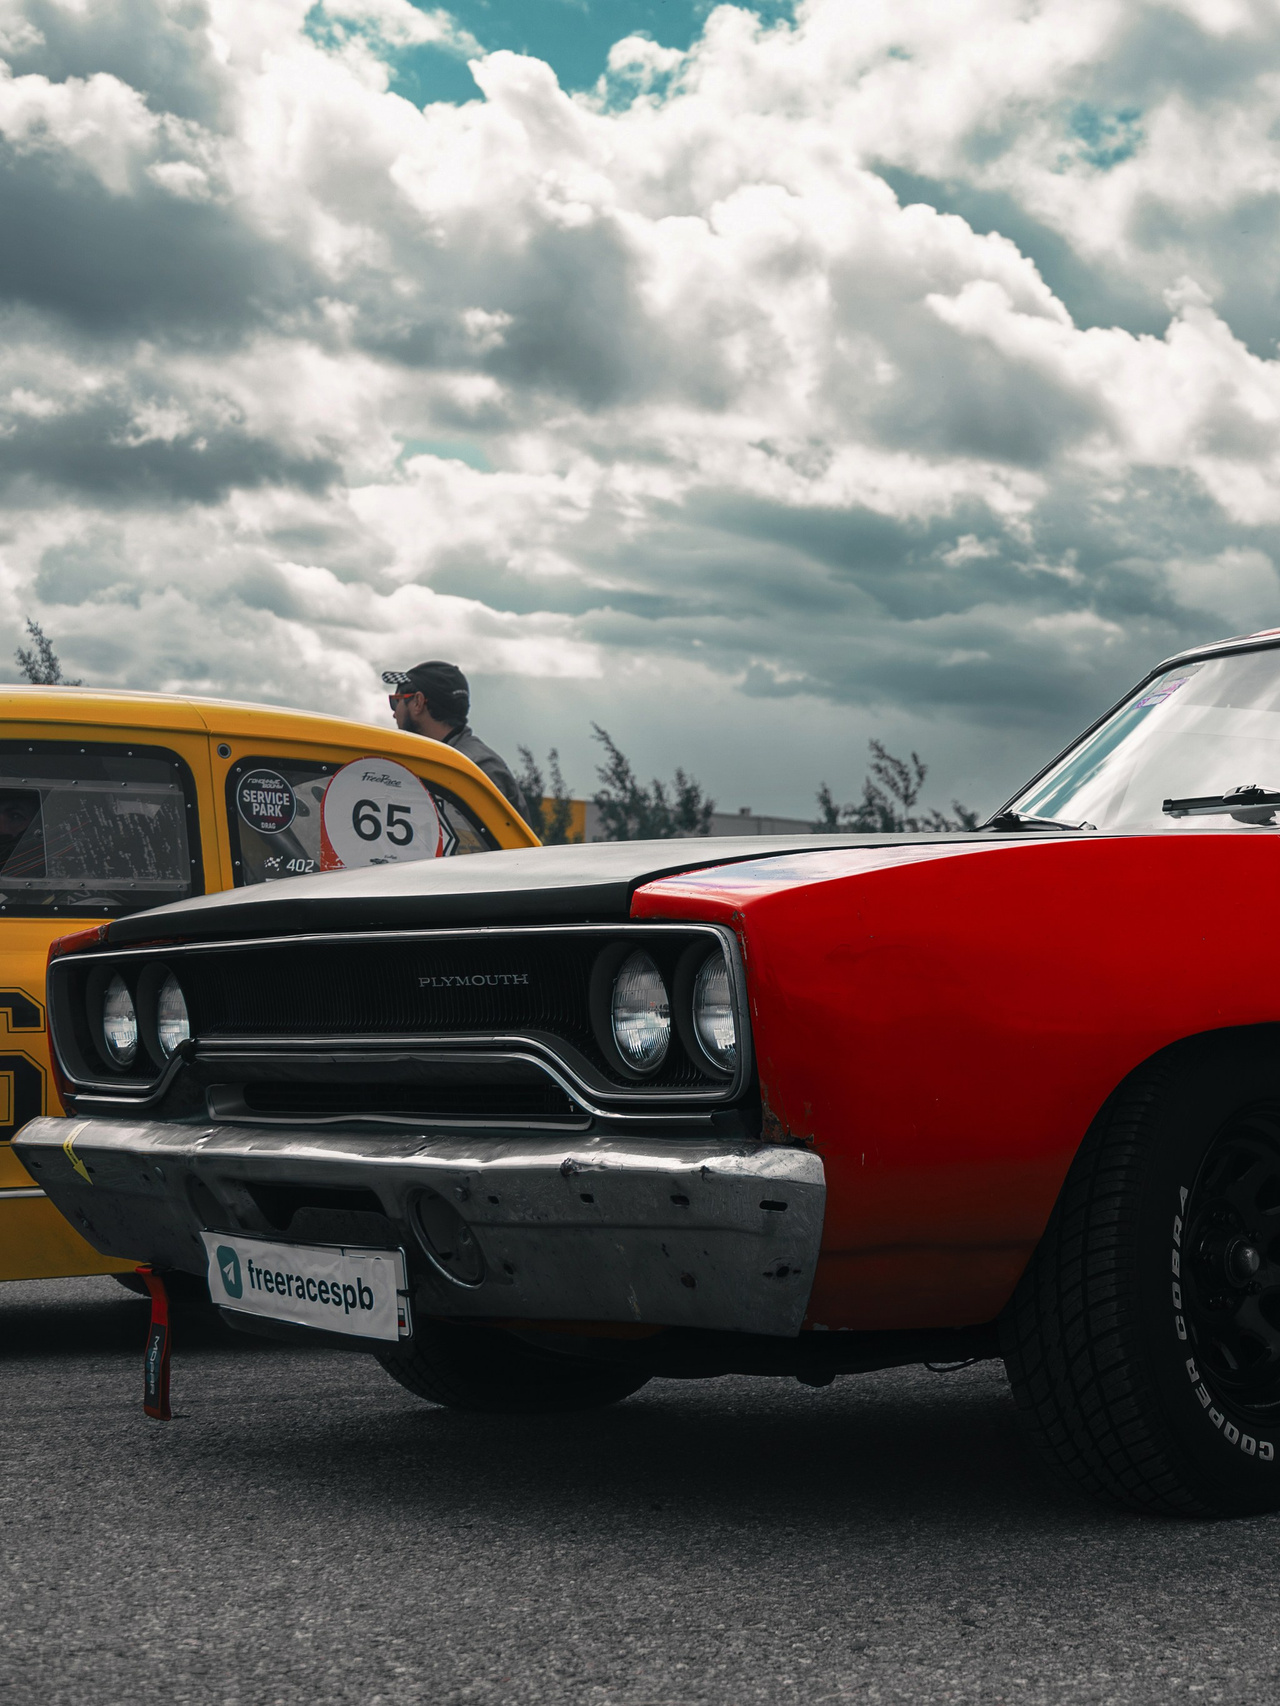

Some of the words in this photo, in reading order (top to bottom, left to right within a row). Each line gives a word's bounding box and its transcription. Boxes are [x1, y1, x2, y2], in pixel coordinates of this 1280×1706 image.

[361, 771, 402, 788] FreeRace
[243, 789, 290, 806] SERVICE
[252, 803, 283, 817] PARK
[352, 799, 414, 846] 65
[286, 858, 315, 873] 402
[418, 974, 529, 987] PLYMOUTH
[1171, 1185, 1189, 1341] COBRA
[247, 1259, 374, 1315] freeracespb
[1185, 1357, 1274, 1461] COOPER
